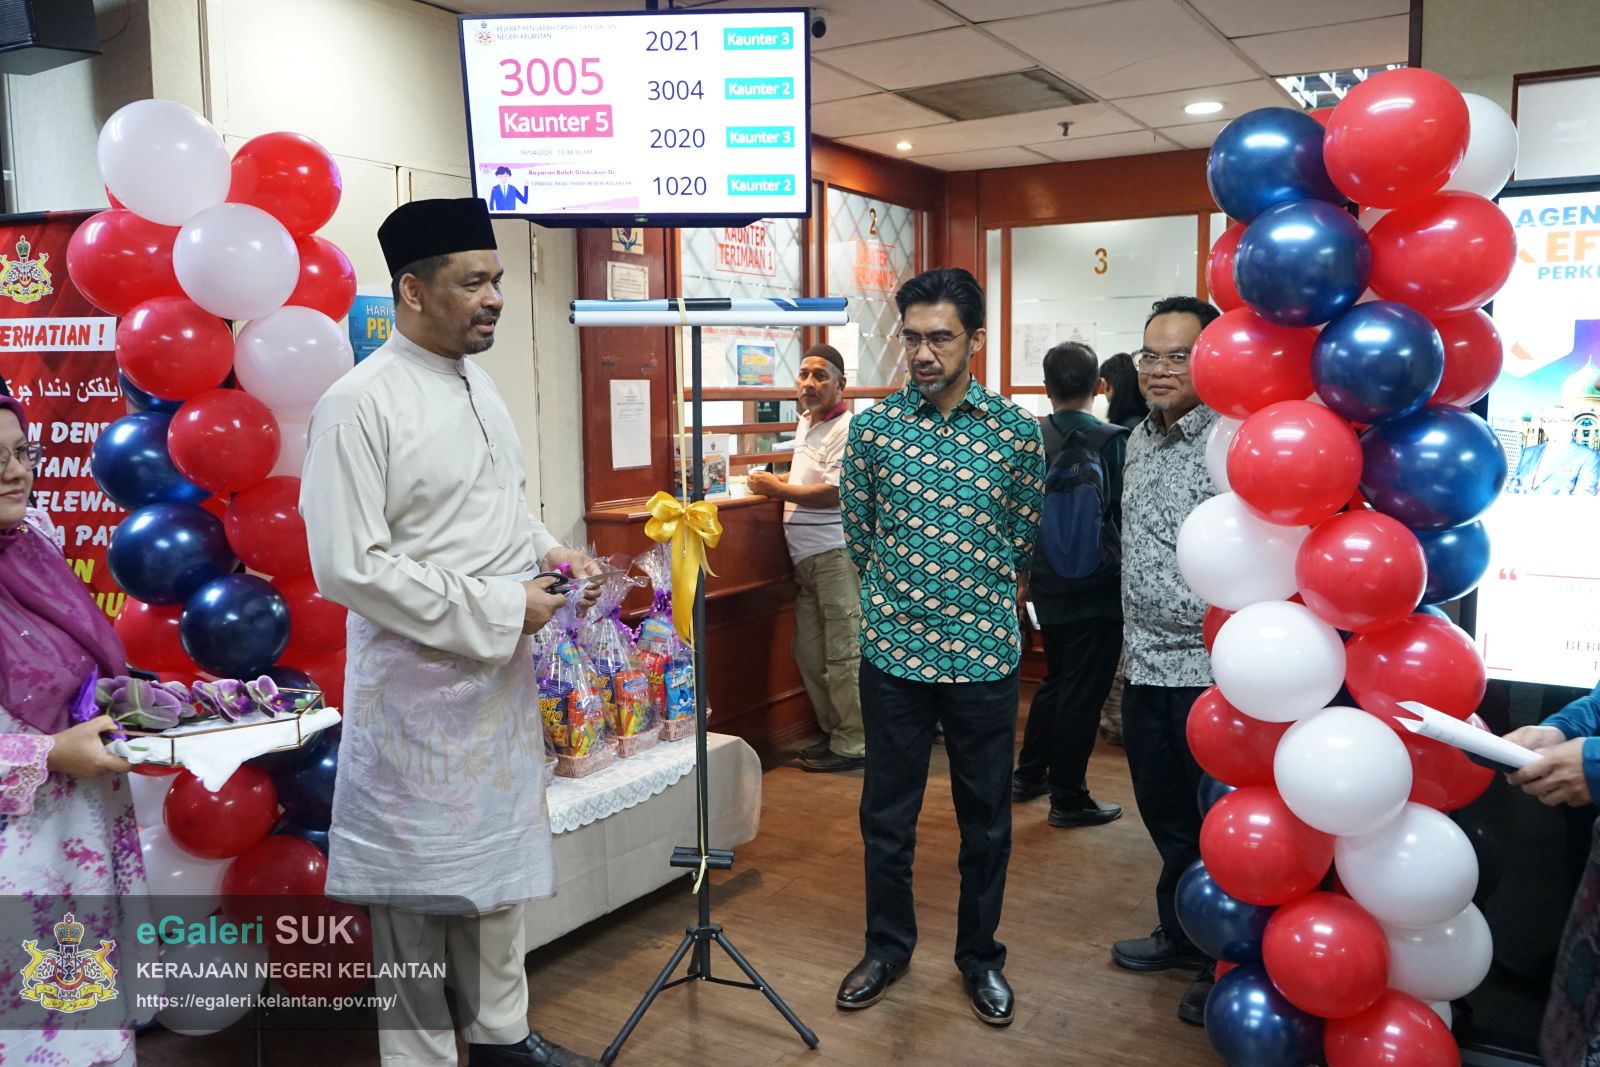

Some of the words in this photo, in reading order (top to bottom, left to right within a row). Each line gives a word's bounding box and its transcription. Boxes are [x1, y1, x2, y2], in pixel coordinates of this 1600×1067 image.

[645, 30, 698, 51] 2021
[727, 32, 779, 46] Kaunter
[781, 32, 790, 45] 3
[499, 57, 604, 97] 3005
[647, 80, 704, 101] 3004
[728, 82, 780, 96] Kaunter
[782, 82, 791, 95] 2
[504, 112, 590, 133] Kaunter
[595, 111, 609, 132] 5
[650, 128, 706, 149] 2020
[729, 130, 781, 144] Kaunter
[782, 131, 791, 144] 3
[653, 176, 707, 196] 1020
[731, 179, 781, 192] Kaunter
[783, 179, 792, 192] 2
[869, 208, 877, 235] 2
[1515, 205, 1600, 228] AGEN
[724, 225, 766, 247] KAUNTER
[719, 243, 766, 269] TERIMAAN
[768, 250, 773, 270] 1
[1093, 247, 1109, 275] 3
[366, 304, 389, 316] HARI
[33, 490, 126, 513] ELEWA
